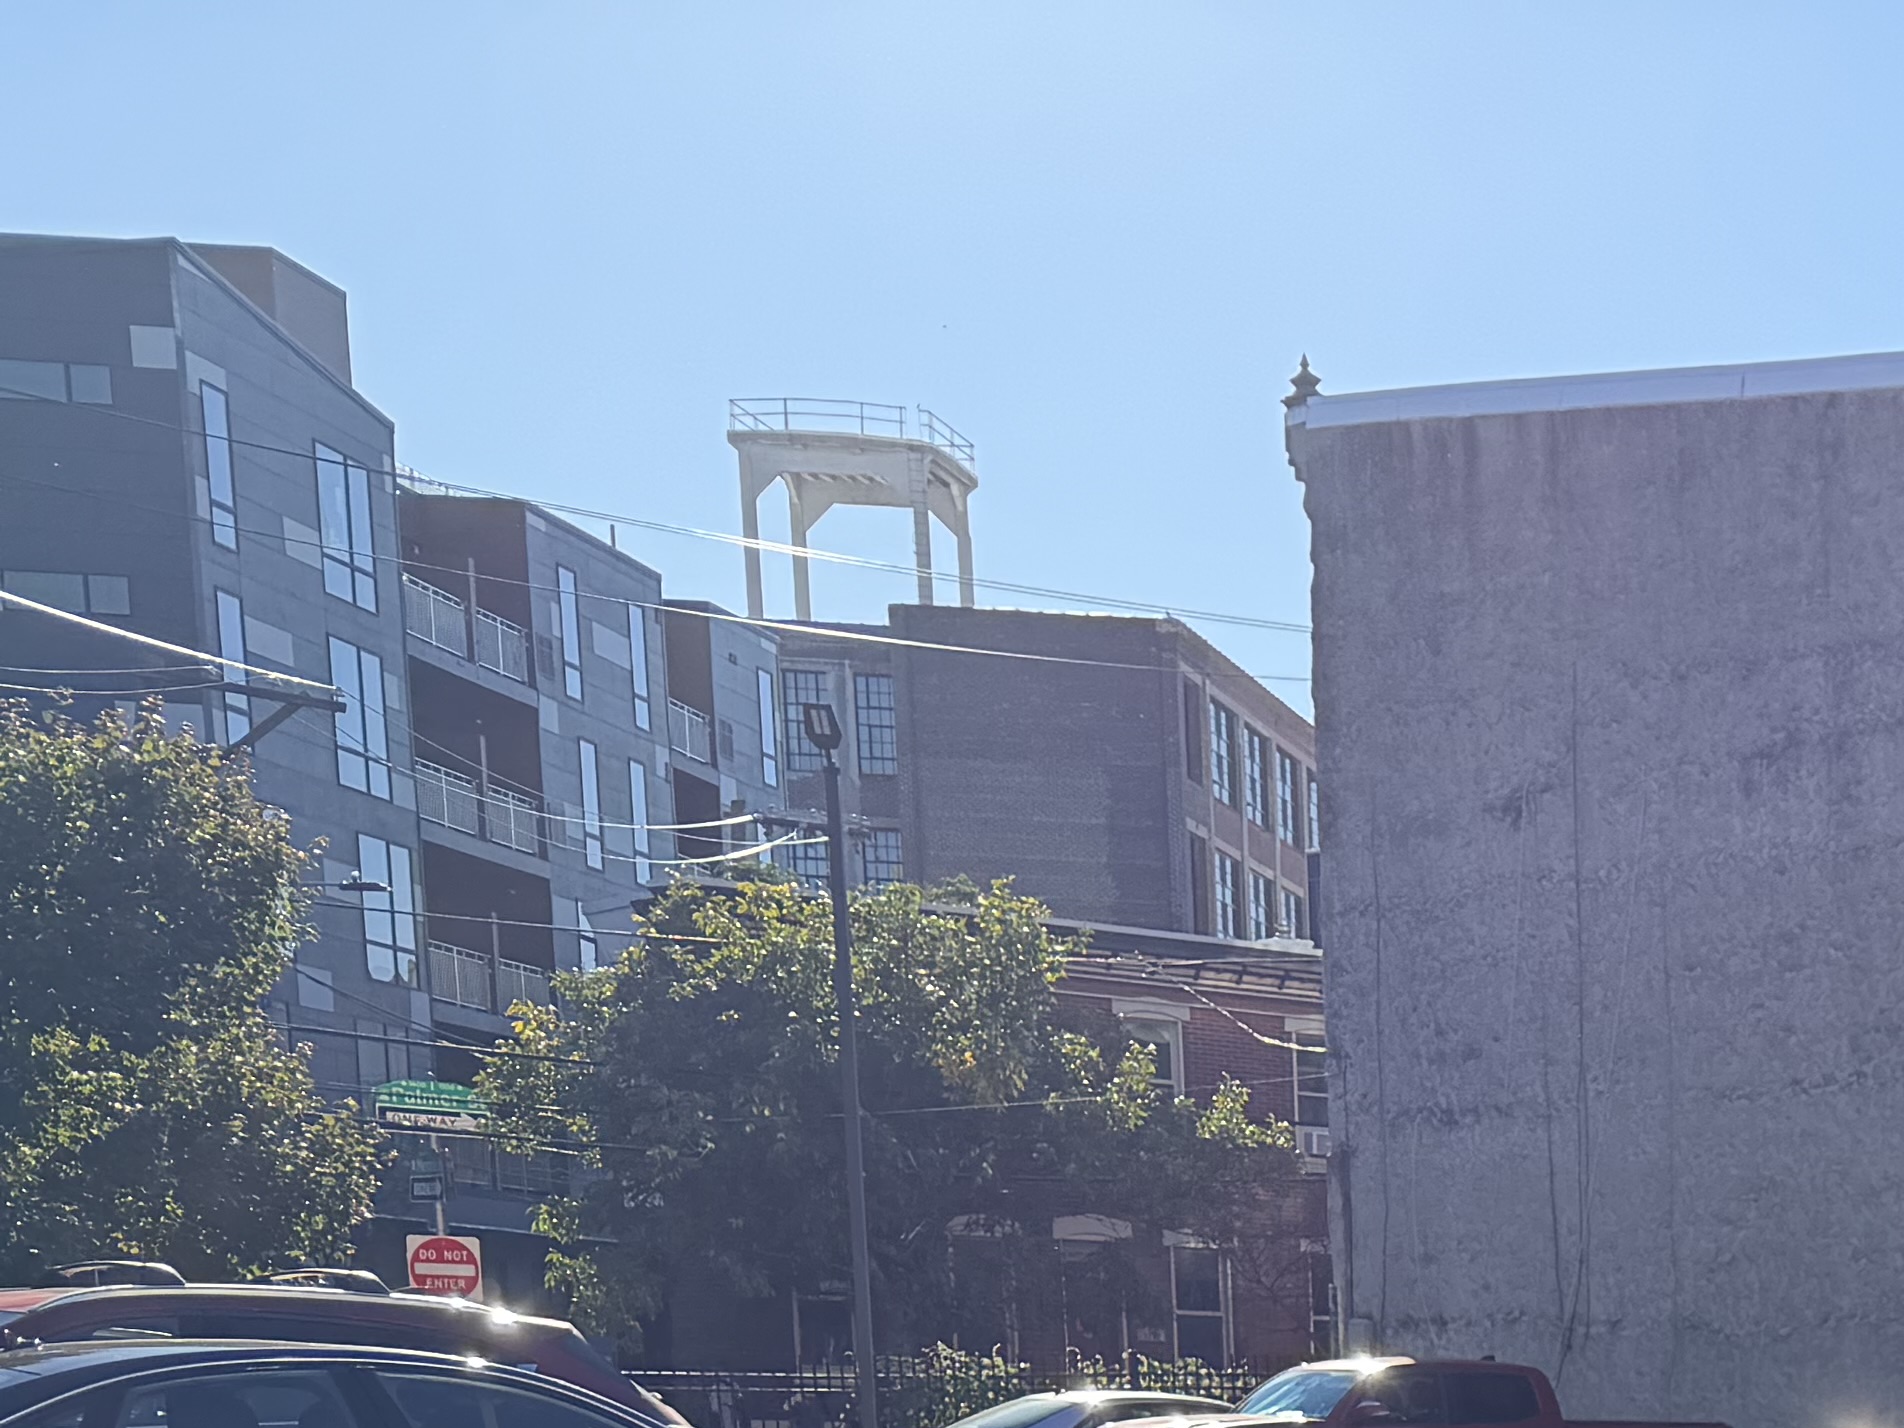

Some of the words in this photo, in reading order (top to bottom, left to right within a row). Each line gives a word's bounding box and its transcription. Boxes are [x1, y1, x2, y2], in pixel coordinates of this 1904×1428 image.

[426, 1116, 457, 1127] WAY
[418, 1249, 436, 1260] DO
[443, 1249, 468, 1261] NOT
[426, 1277, 466, 1289] ENTER
